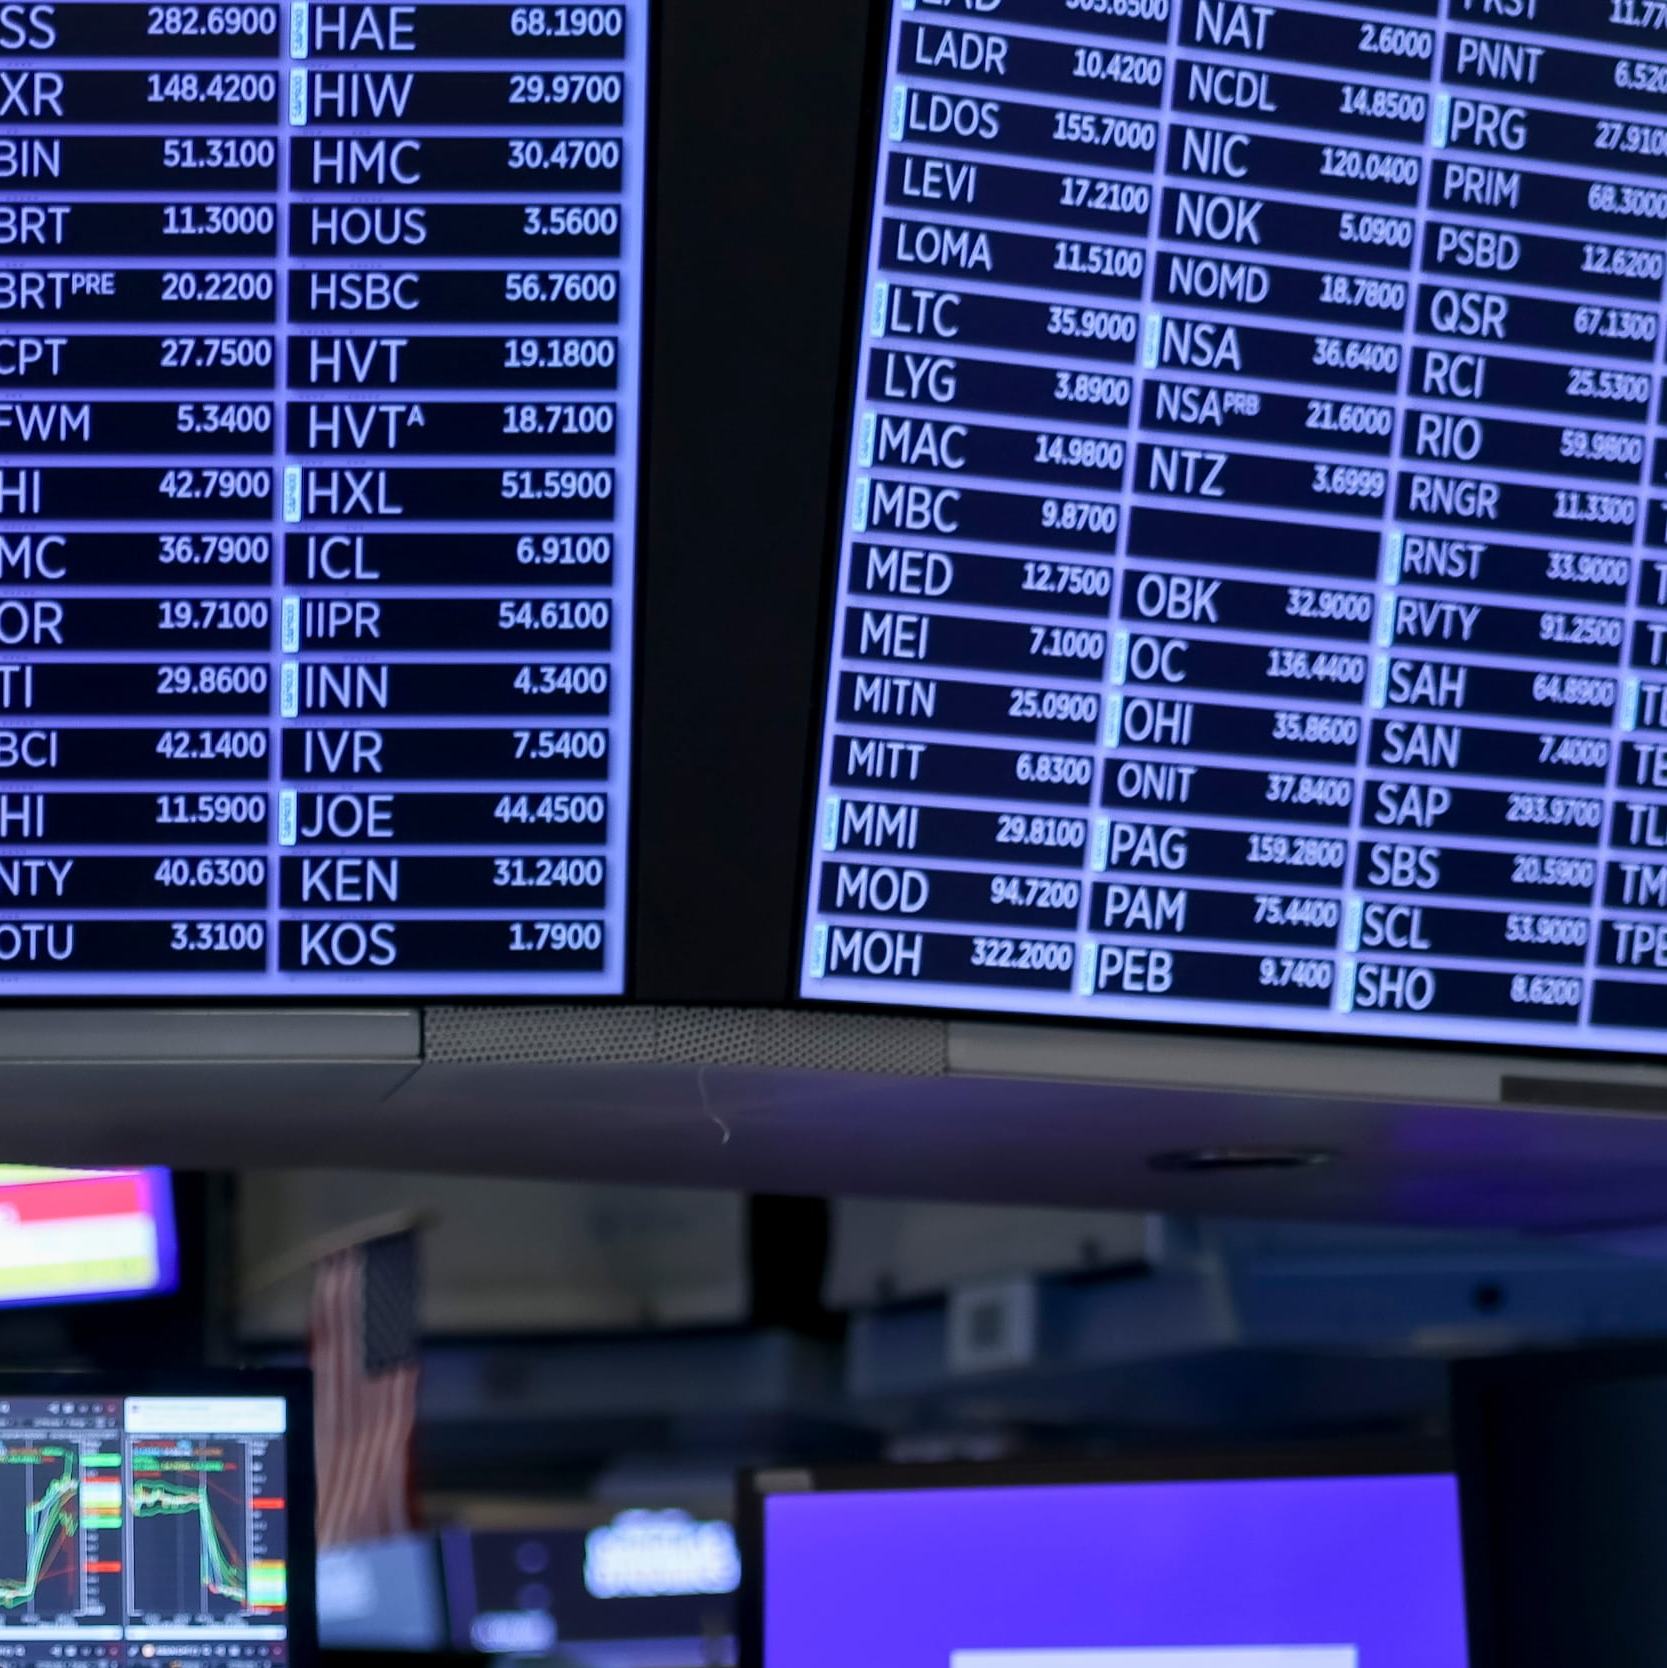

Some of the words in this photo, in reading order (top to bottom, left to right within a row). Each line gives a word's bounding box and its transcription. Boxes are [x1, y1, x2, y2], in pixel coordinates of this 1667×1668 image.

[314, 5, 417, 51] HAE
[510, 7, 624, 37] 68.1900
[1194, 0, 1276, 51] NAT
[1358, 23, 1432, 60] 2.6000
[914, 25, 1009, 76] LADR
[1072, 48, 1163, 87] 10.4200
[1456, 36, 1546, 84] PNNT
[313, 73, 415, 118] HIW
[508, 73, 622, 104] 29.9700
[1181, 128, 1252, 178] NIC
[902, 156, 978, 203] LEVI
[1059, 176, 1150, 215] 17.2100
[162, 204, 275, 235] 11.3000
[896, 222, 994, 272] LOMA
[1053, 241, 1143, 279] 11.5100
[1436, 225, 1521, 271] PSBD
[1168, 255, 1271, 304] NOMD
[890, 287, 962, 338] LTC
[1046, 306, 1137, 343] 35.9000
[1429, 288, 1509, 339] QSR
[309, 337, 409, 383] HVT
[504, 338, 616, 368] 19.1800
[878, 416, 969, 470] MAC
[1034, 434, 1123, 471] 14.9800
[158, 534, 270, 564] 36.7900
[865, 546, 954, 597] MED
[1021, 562, 1111, 597] 12.7500
[158, 600, 269, 629] 19.7100
[1136, 573, 1222, 624] OBK
[305, 665, 389, 709] INN
[513, 665, 608, 694] 4.3400
[853, 674, 937, 718] MITN
[1007, 689, 1098, 723] 25.0900
[1123, 699, 1194, 746] OHI
[304, 730, 383, 773] IVR
[512, 730, 607, 759] 7.5400
[841, 802, 920, 850] MMI
[995, 815, 1086, 849] 29.8100
[1374, 783, 1452, 828] SAP
[154, 857, 266, 887] 40.6300
[1103, 884, 1188, 933] PAM
[170, 921, 265, 951] 3.3100
[829, 928, 924, 977] MOH
[970, 938, 1073, 972] 322.2000
[1356, 964, 1436, 1011] SHO
